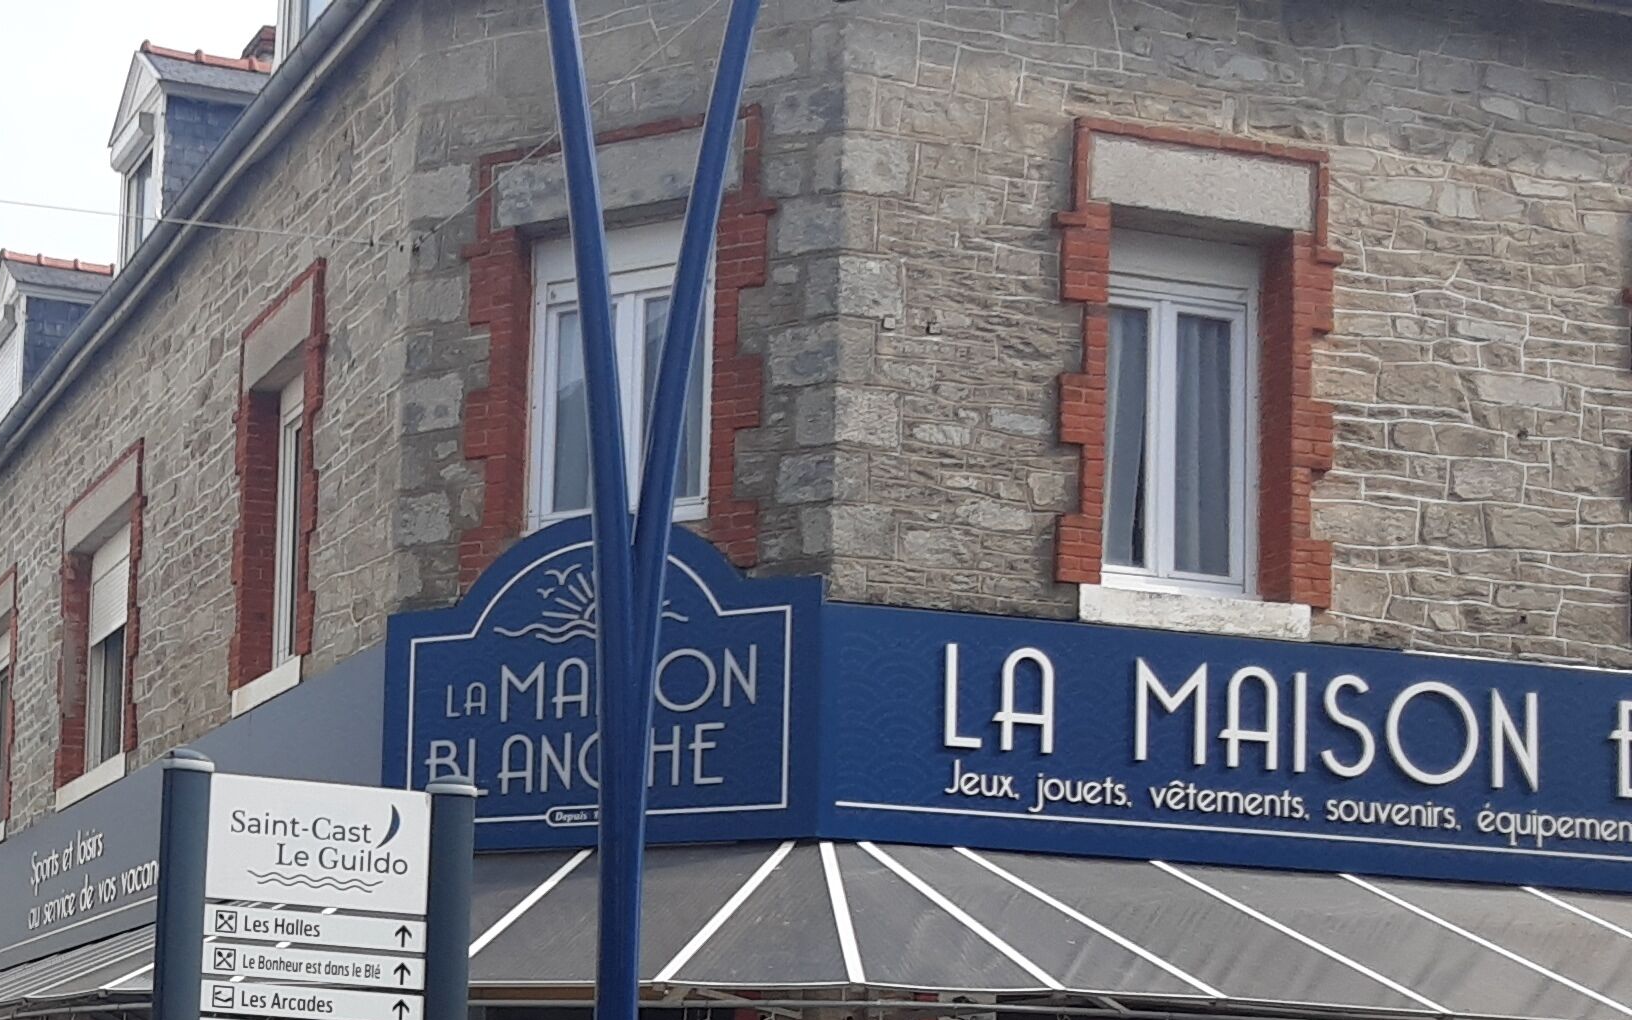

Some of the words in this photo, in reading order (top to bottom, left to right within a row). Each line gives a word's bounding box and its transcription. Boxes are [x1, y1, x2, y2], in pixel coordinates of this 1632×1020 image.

[446, 681, 487, 718] LA
[500, 643, 758, 722] MAON
[943, 642, 1055, 754] LA
[1133, 657, 1539, 792] MAISON
[230, 810, 372, 844] Saint-Cast
[30, 851, 59, 896] Sports
[62, 840, 73, 871] et
[77, 828, 104, 865] loisirs
[275, 843, 309, 866] Le
[318, 847, 408, 875] Guildo
[28, 908, 41, 929] au
[43, 889, 75, 925] service
[80, 874, 94, 911] de
[99, 876, 116, 903] vos
[244, 915, 269, 934] Les
[273, 916, 321, 938] Halles
[243, 954, 255, 969] Le
[258, 955, 302, 973] Bonheur
[305, 961, 321, 975] est
[324, 960, 349, 978] dans
[352, 962, 362, 978] le
[364, 962, 381, 979] Blé
[241, 990, 267, 1008] Les
[271, 992, 333, 1014] Arcades
